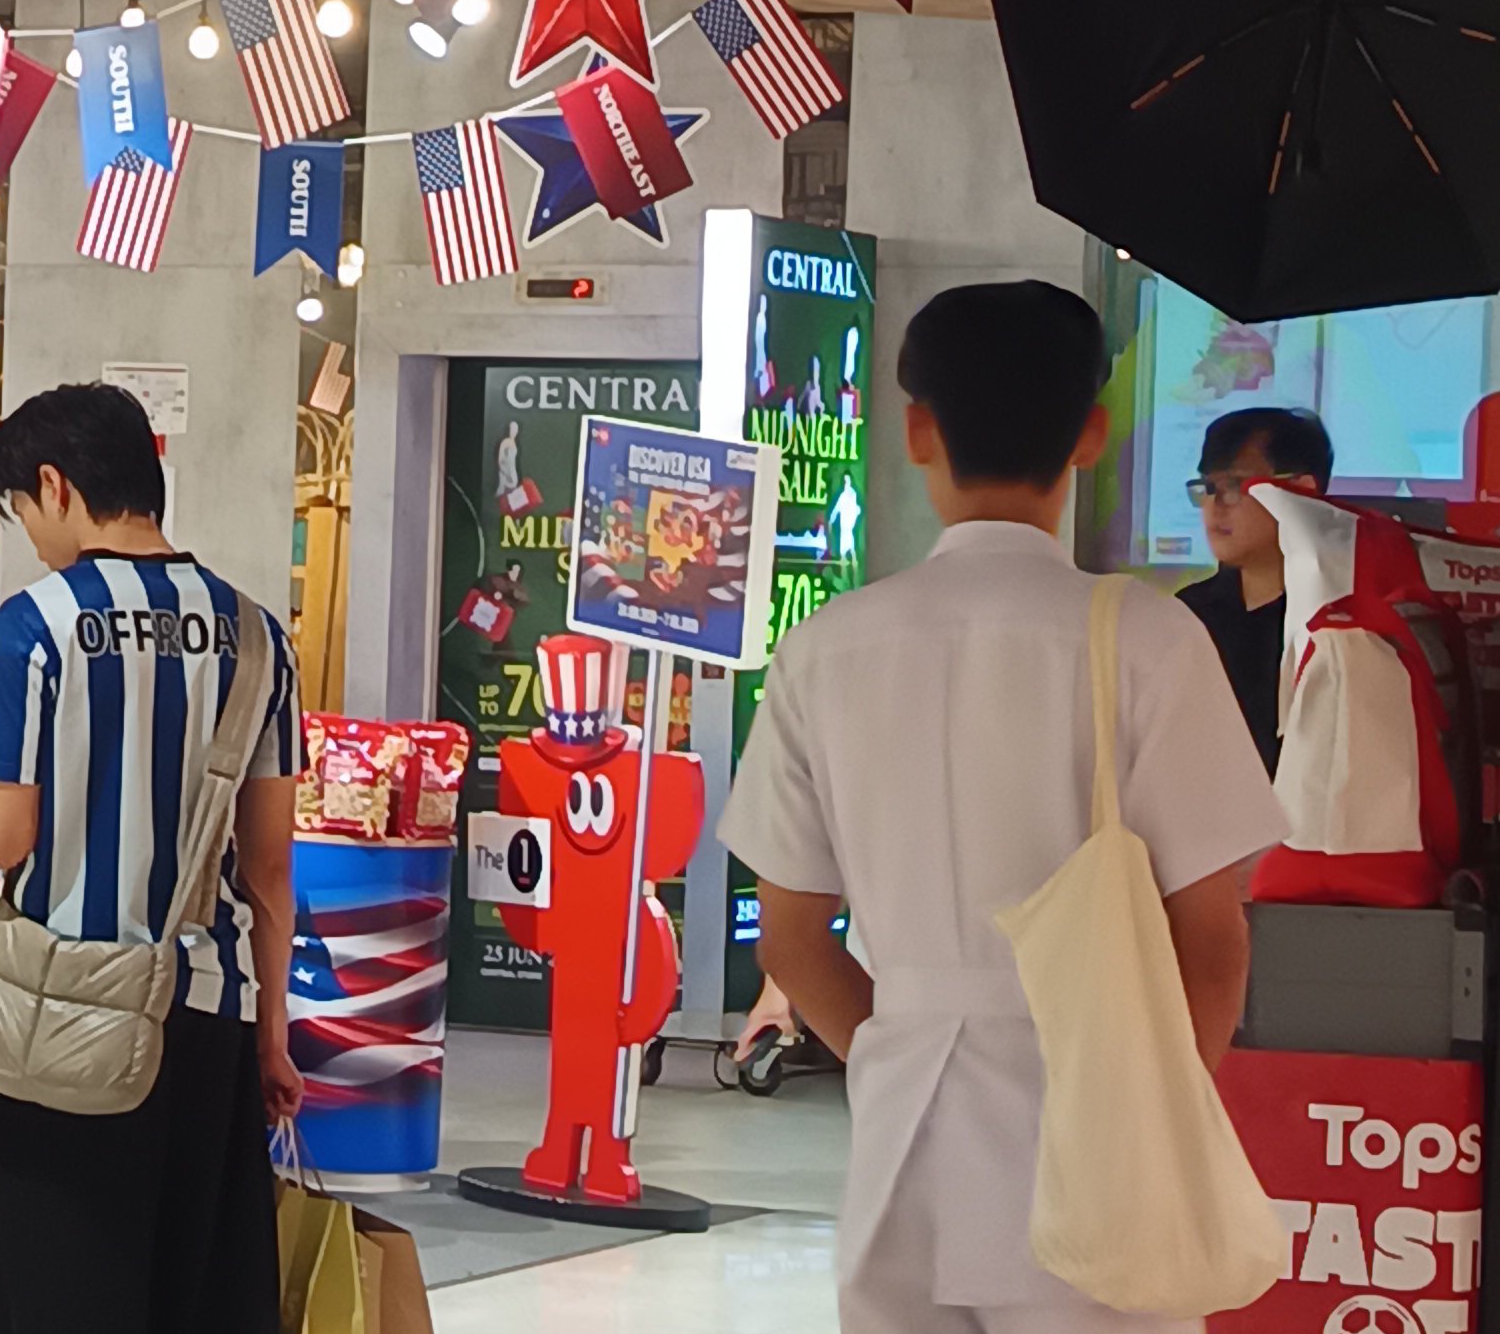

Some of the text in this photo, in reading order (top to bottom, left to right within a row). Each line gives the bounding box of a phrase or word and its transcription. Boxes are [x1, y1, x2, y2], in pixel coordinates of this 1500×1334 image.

[107, 43, 138, 135] SOUTH
[593, 84, 657, 199] NORTHEAST
[288, 158, 312, 238] SOUTH
[767, 249, 857, 298] CENTRAL
[506, 375, 699, 412] CENTRA
[751, 407, 864, 460] MIDNIGHT
[778, 458, 828, 505] SALE
[76, 608, 238, 660] OFFROA
[479, 684, 500, 698] UP
[479, 700, 499, 716] TO
[475, 844, 504, 871] The
[1308, 1102, 1482, 1190] Tops
[1268, 1198, 1483, 1293] TAST
